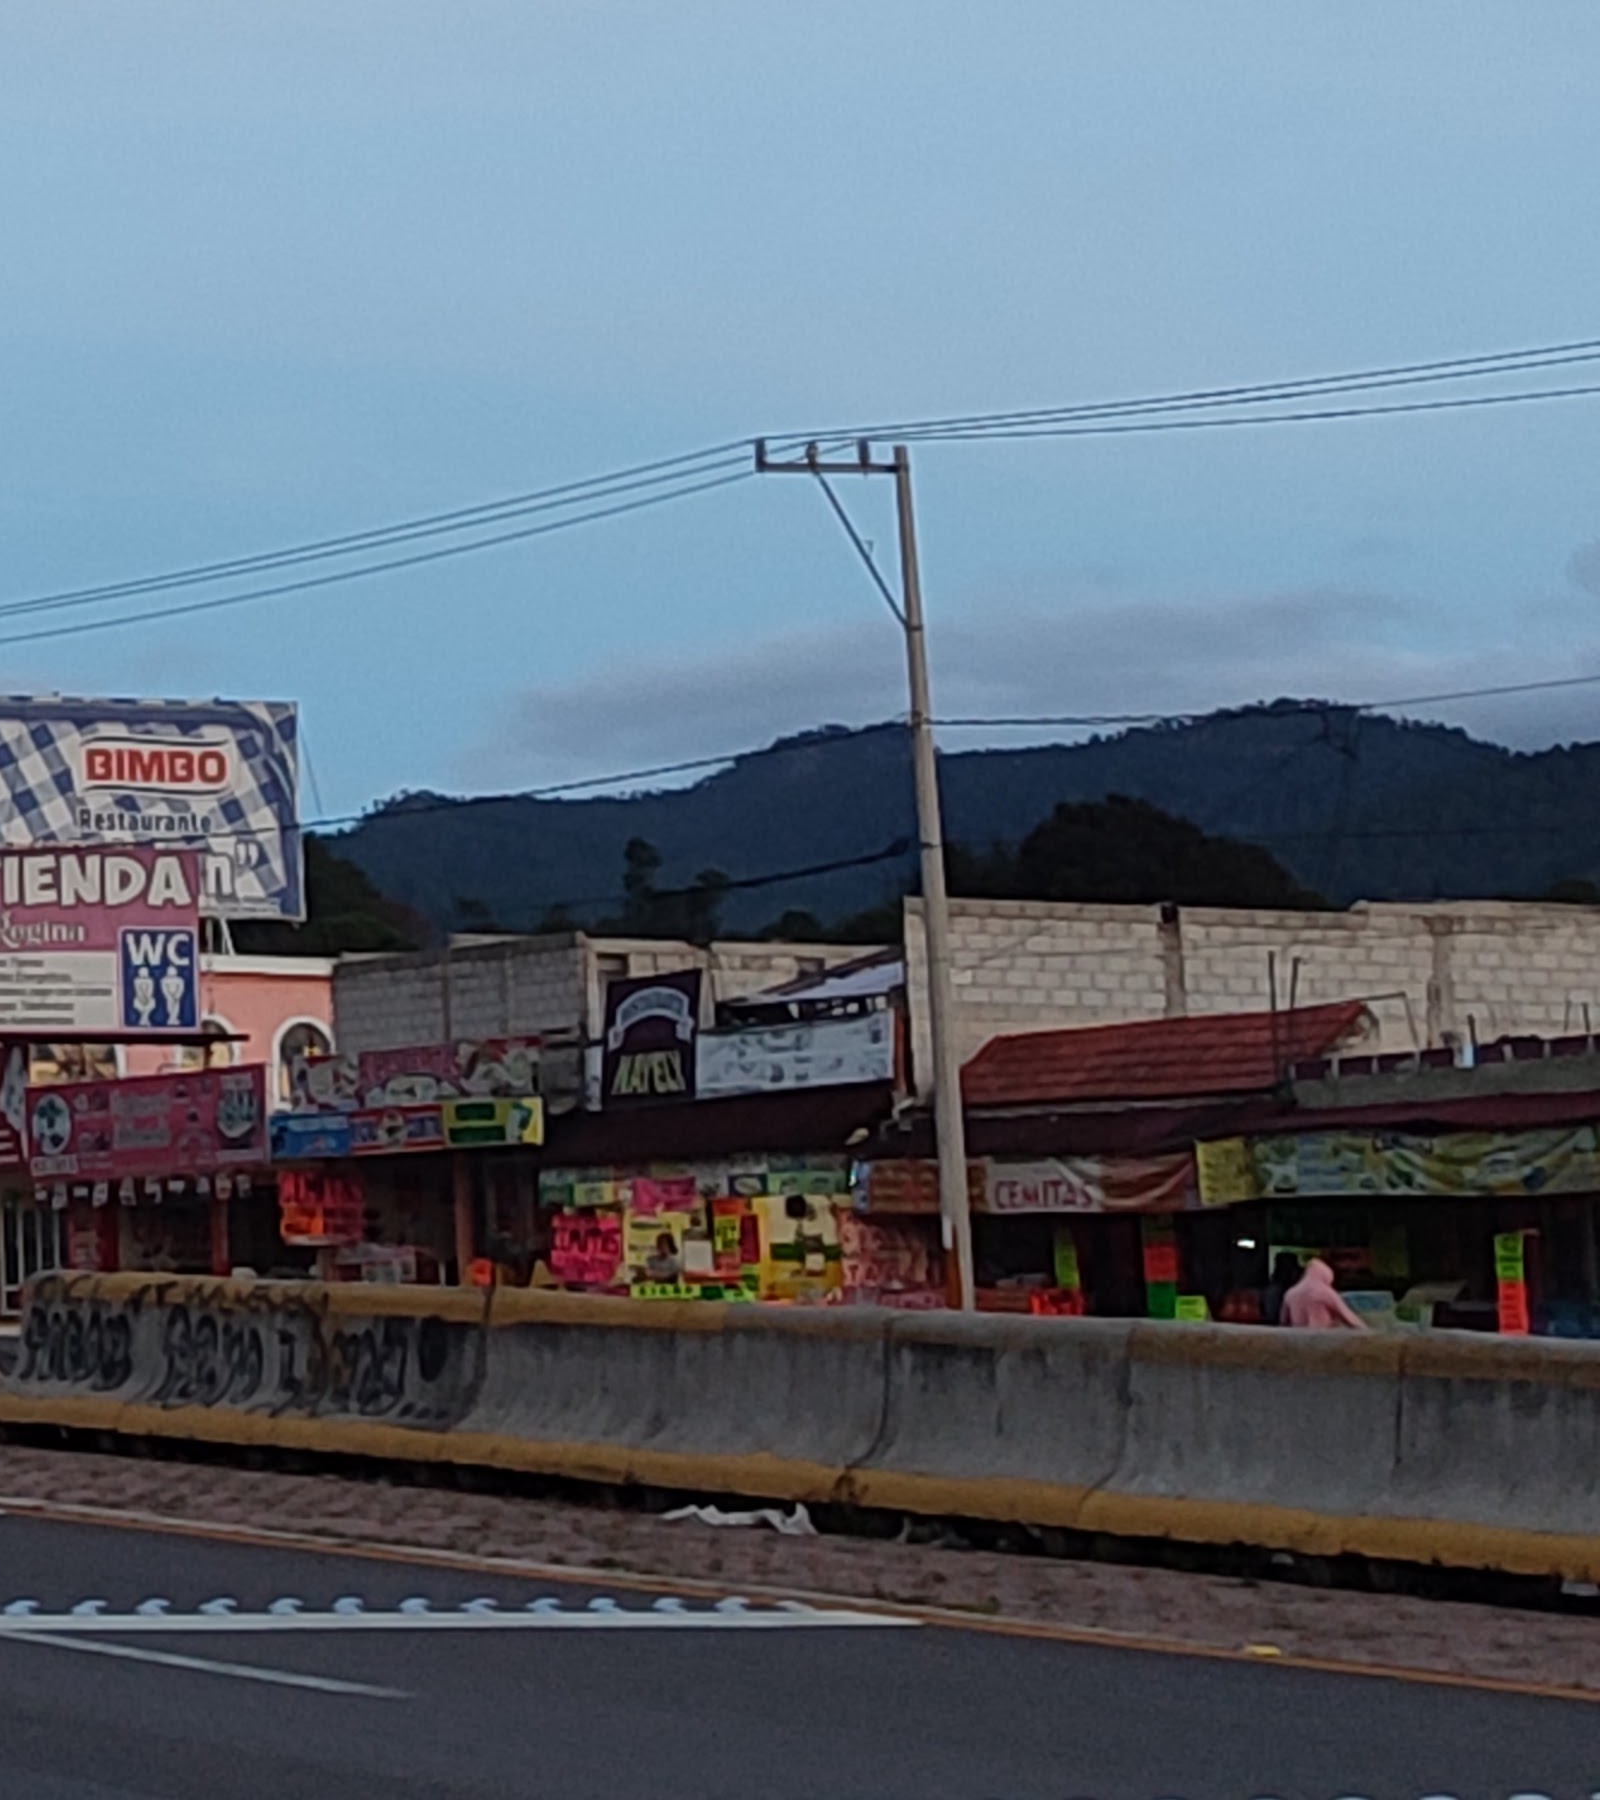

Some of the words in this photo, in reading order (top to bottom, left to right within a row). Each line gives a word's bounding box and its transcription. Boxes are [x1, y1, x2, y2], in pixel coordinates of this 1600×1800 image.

[85, 747, 227, 784] BIMBO
[79, 808, 212, 834] Restaurante
[125, 932, 191, 966] WC
